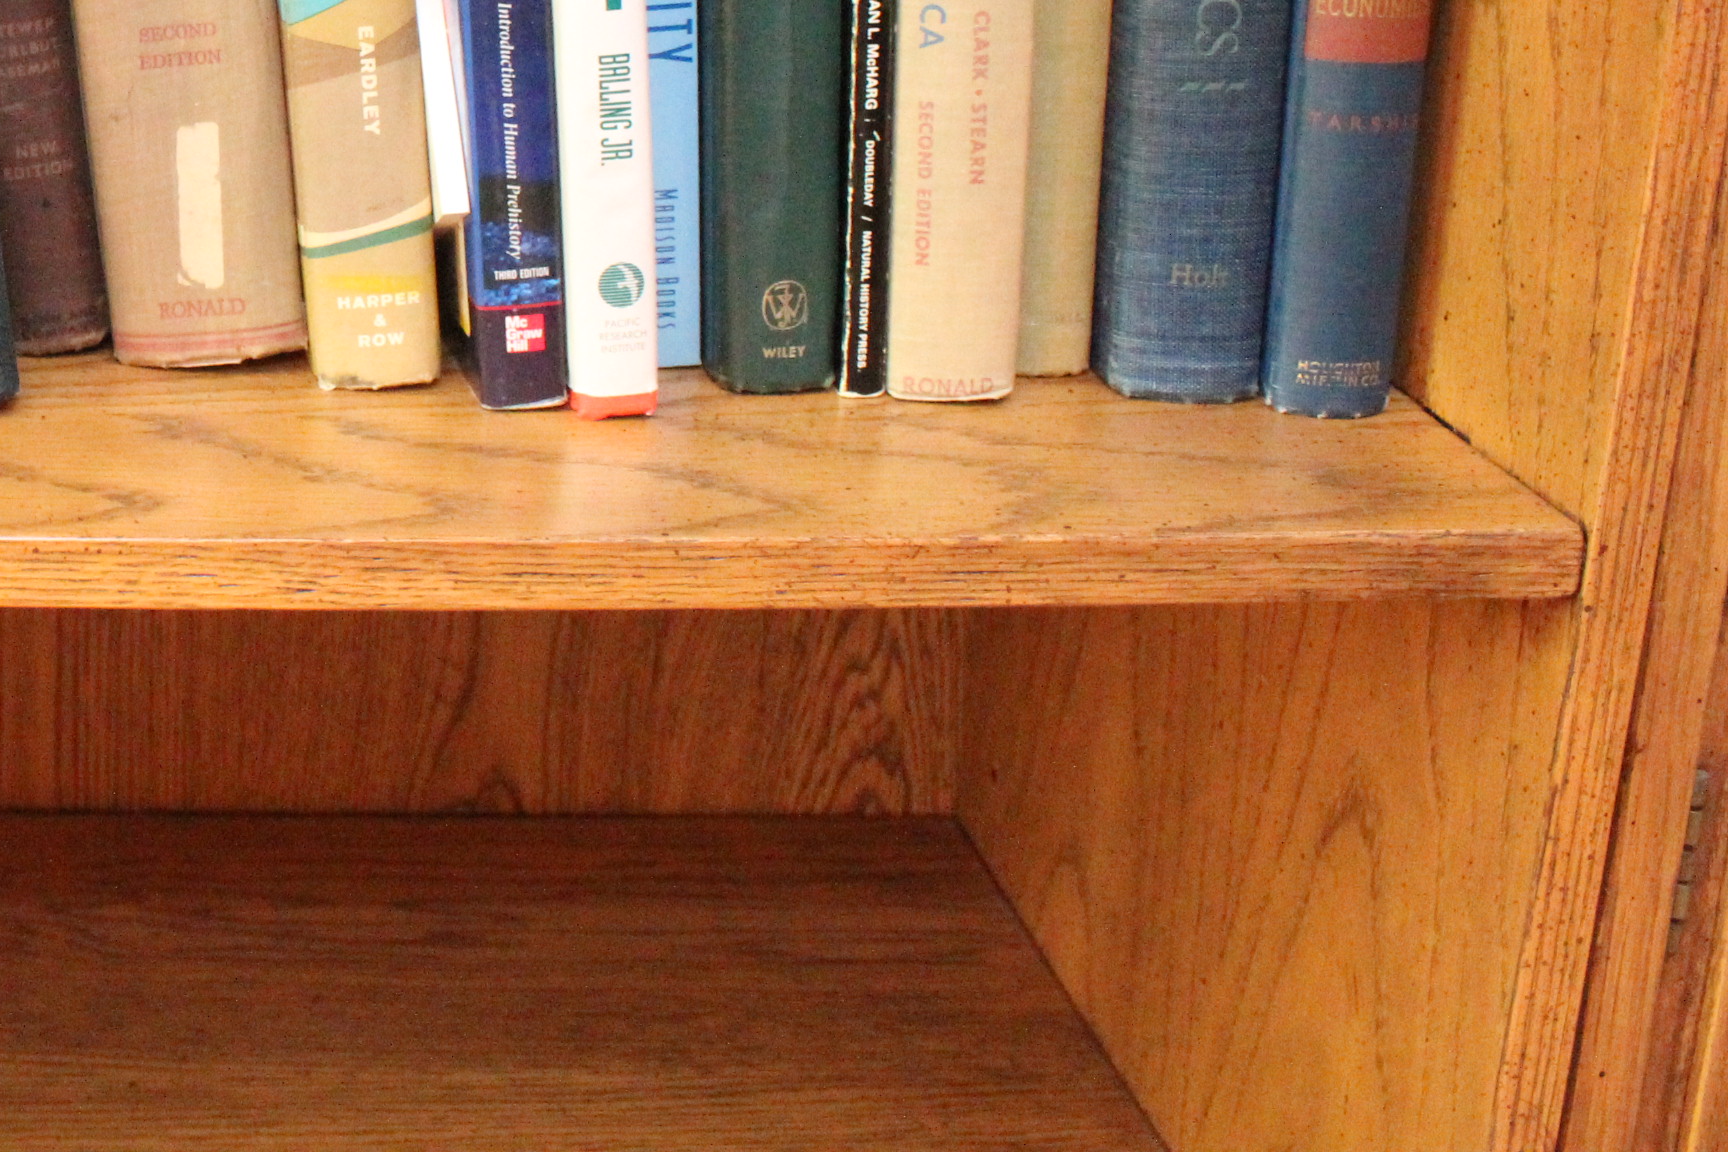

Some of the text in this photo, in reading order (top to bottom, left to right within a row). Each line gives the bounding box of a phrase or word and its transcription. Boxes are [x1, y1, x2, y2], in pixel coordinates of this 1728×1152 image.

[138, 21, 217, 44] SECOND
[868, 27, 881, 42] L.
[139, 49, 222, 70] EDITION
[497, 2, 515, 98] Introduction
[357, 25, 381, 135] EARDLEY
[864, 45, 881, 111] McHARG
[969, 10, 992, 186] CLARK STEARN
[503, 103, 515, 118] to
[598, 53, 634, 167] BALLING JR.
[15, 140, 57, 159] NEW
[504, 122, 519, 179] Human
[915, 101, 935, 268] SECOND EDITION
[506, 184, 522, 260] Prehistory
[858, 140, 876, 333] DOUBLEDAY NATURAL HISTORY
[494, 267, 550, 281] THIRD EDITION
[1171, 264, 1229, 287] Holt
[159, 298, 246, 320] RONALD
[337, 292, 421, 310] HARPER
[374, 314, 387, 327] &
[505, 316, 529, 329] Mc
[604, 317, 641, 328] PACIFIC
[358, 332, 405, 347] ROW
[505, 328, 543, 341] Graw
[599, 329, 647, 341] RESEARCH
[506, 339, 529, 353] Hill
[762, 345, 806, 359] WILEY
[902, 376, 994, 396] RONALD
